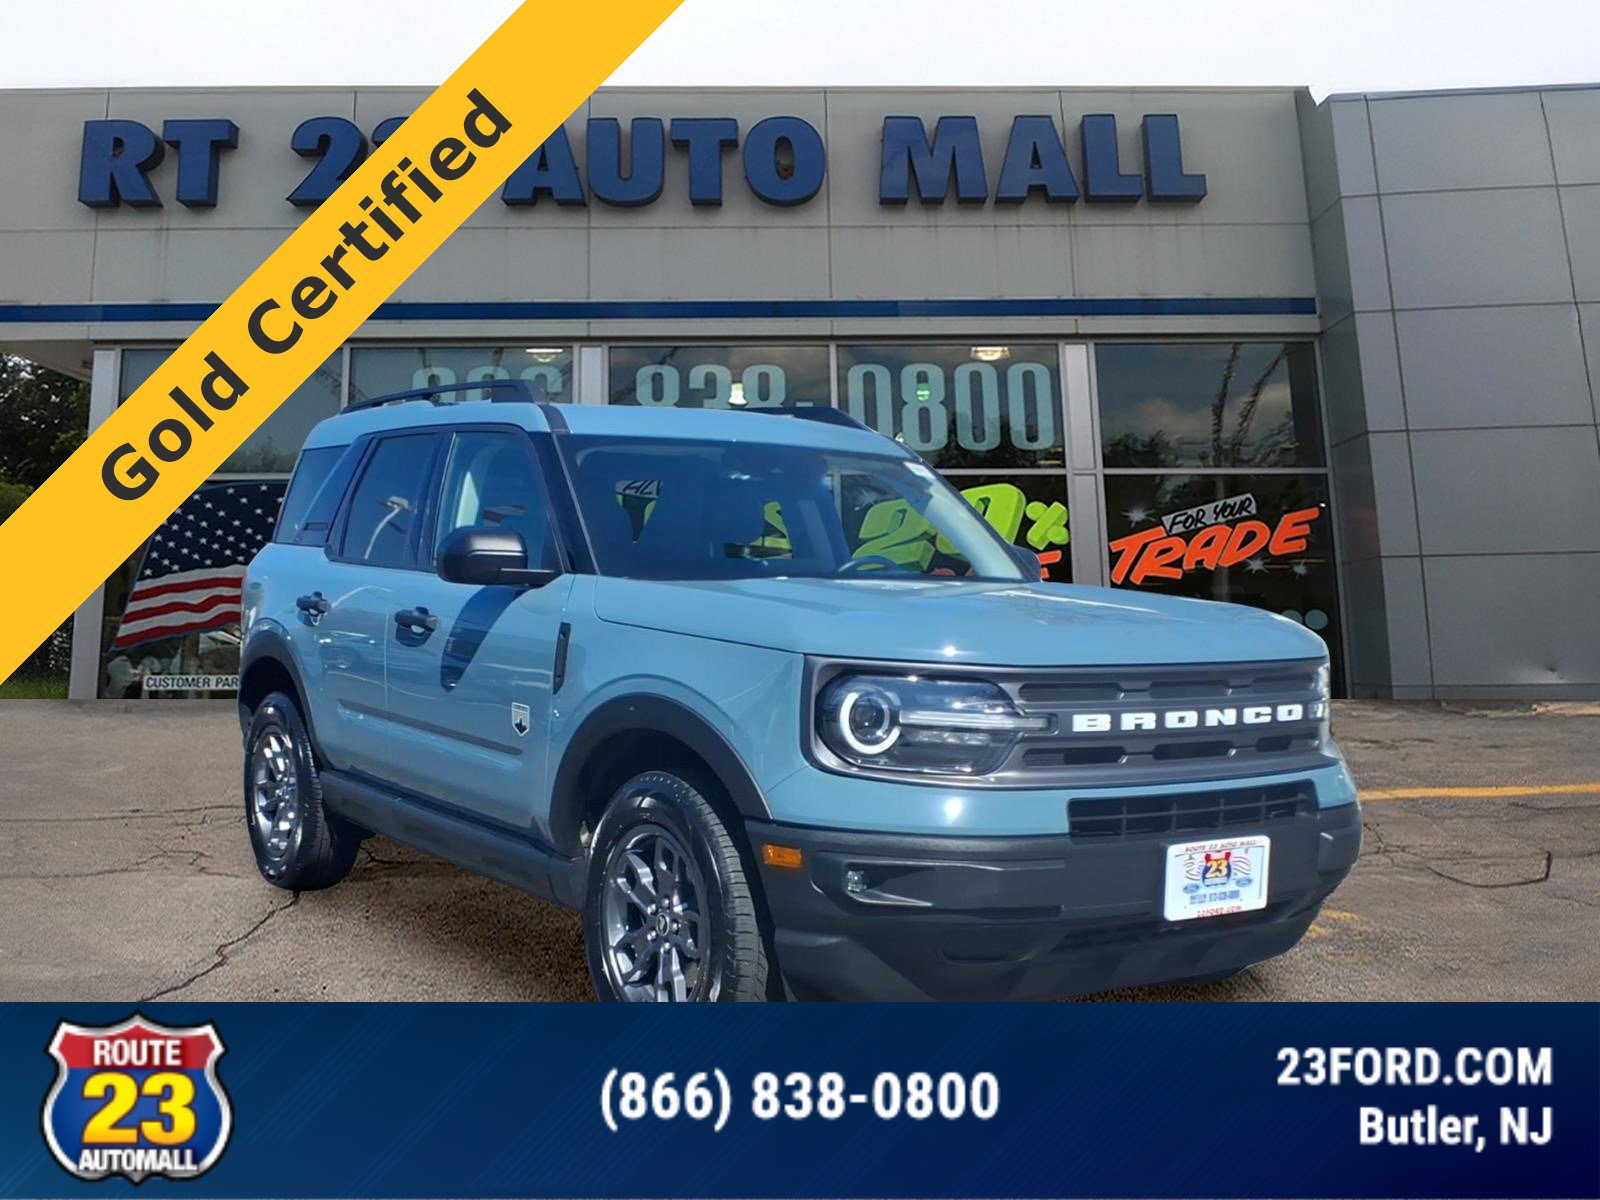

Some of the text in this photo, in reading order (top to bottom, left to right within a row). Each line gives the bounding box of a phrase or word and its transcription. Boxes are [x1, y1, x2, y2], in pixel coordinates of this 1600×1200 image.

[78, 118, 239, 208] RT
[878, 113, 1207, 205] MALL
[1168, 497, 1254, 533] FOR YOUR
[1108, 506, 1320, 586] TRADE
[145, 676, 211, 688] CUSTOMER
[1072, 703, 1303, 732] BRONCO
[1205, 859, 1228, 879] 23
